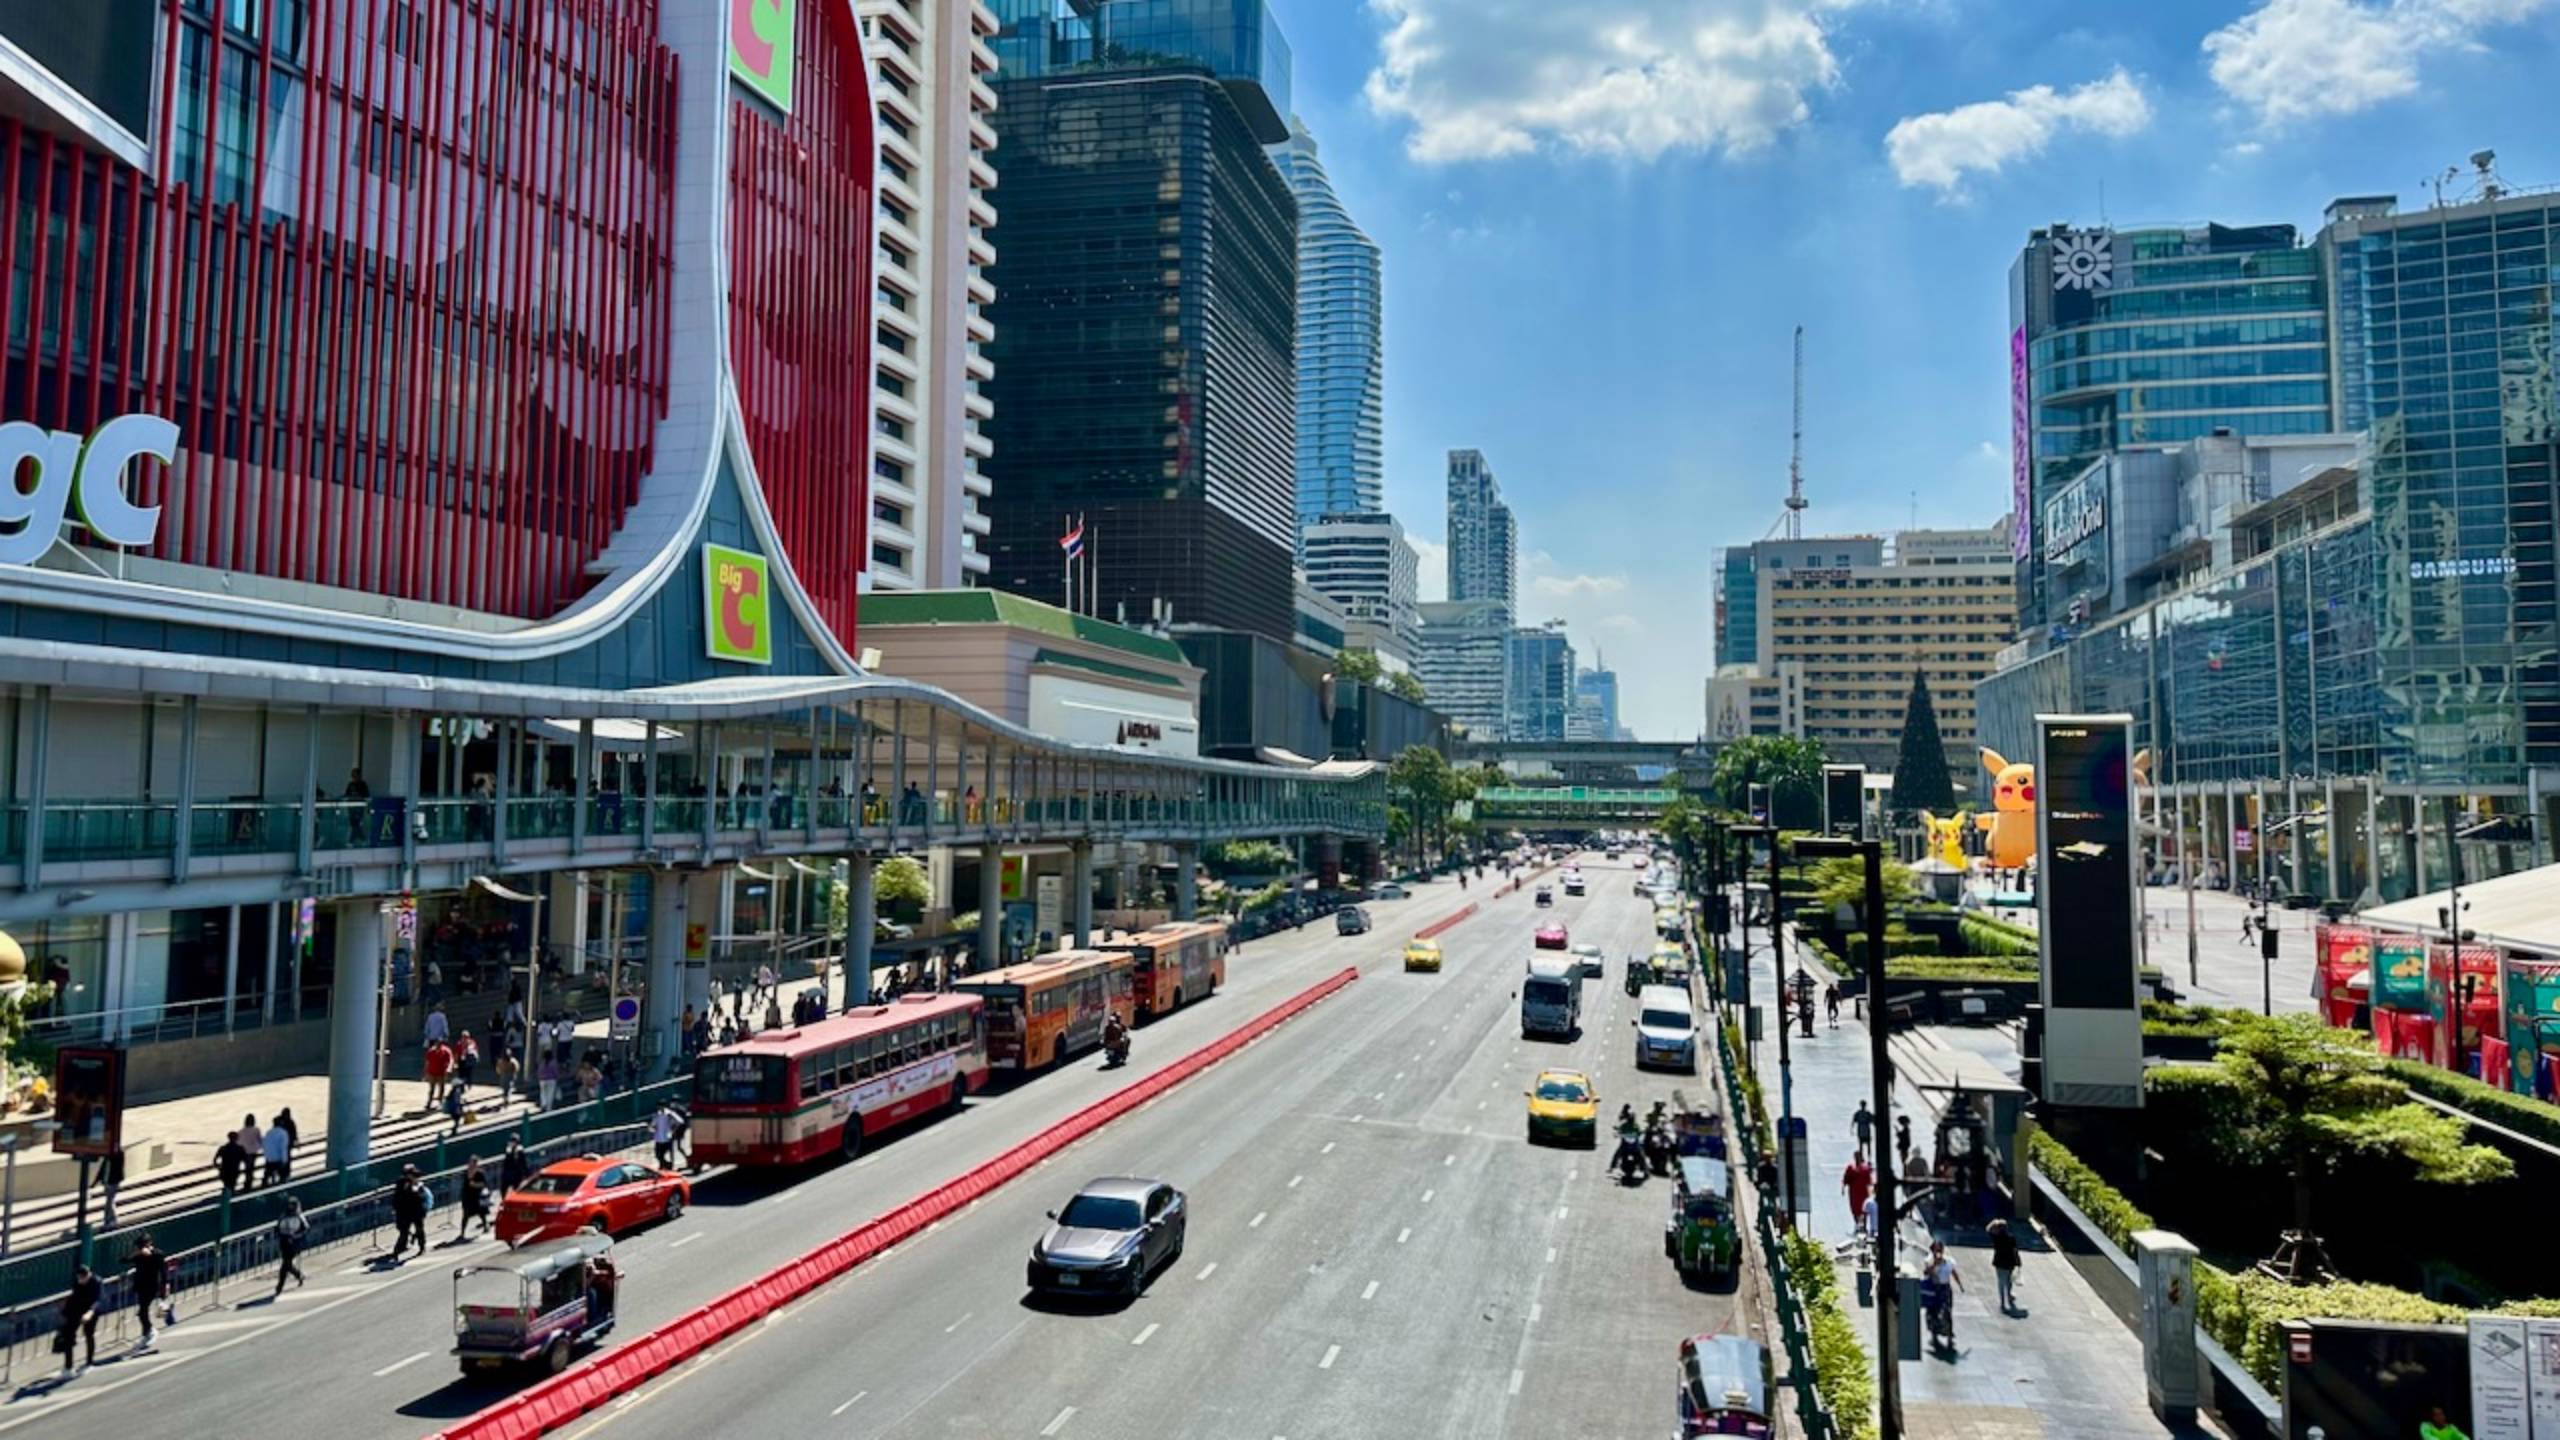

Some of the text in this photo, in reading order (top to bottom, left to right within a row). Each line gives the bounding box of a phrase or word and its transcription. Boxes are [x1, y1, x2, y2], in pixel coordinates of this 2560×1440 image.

[719, 563, 743, 594] Big
[2410, 557, 2517, 578] SAMSUNG
[722, 566, 760, 651] C
